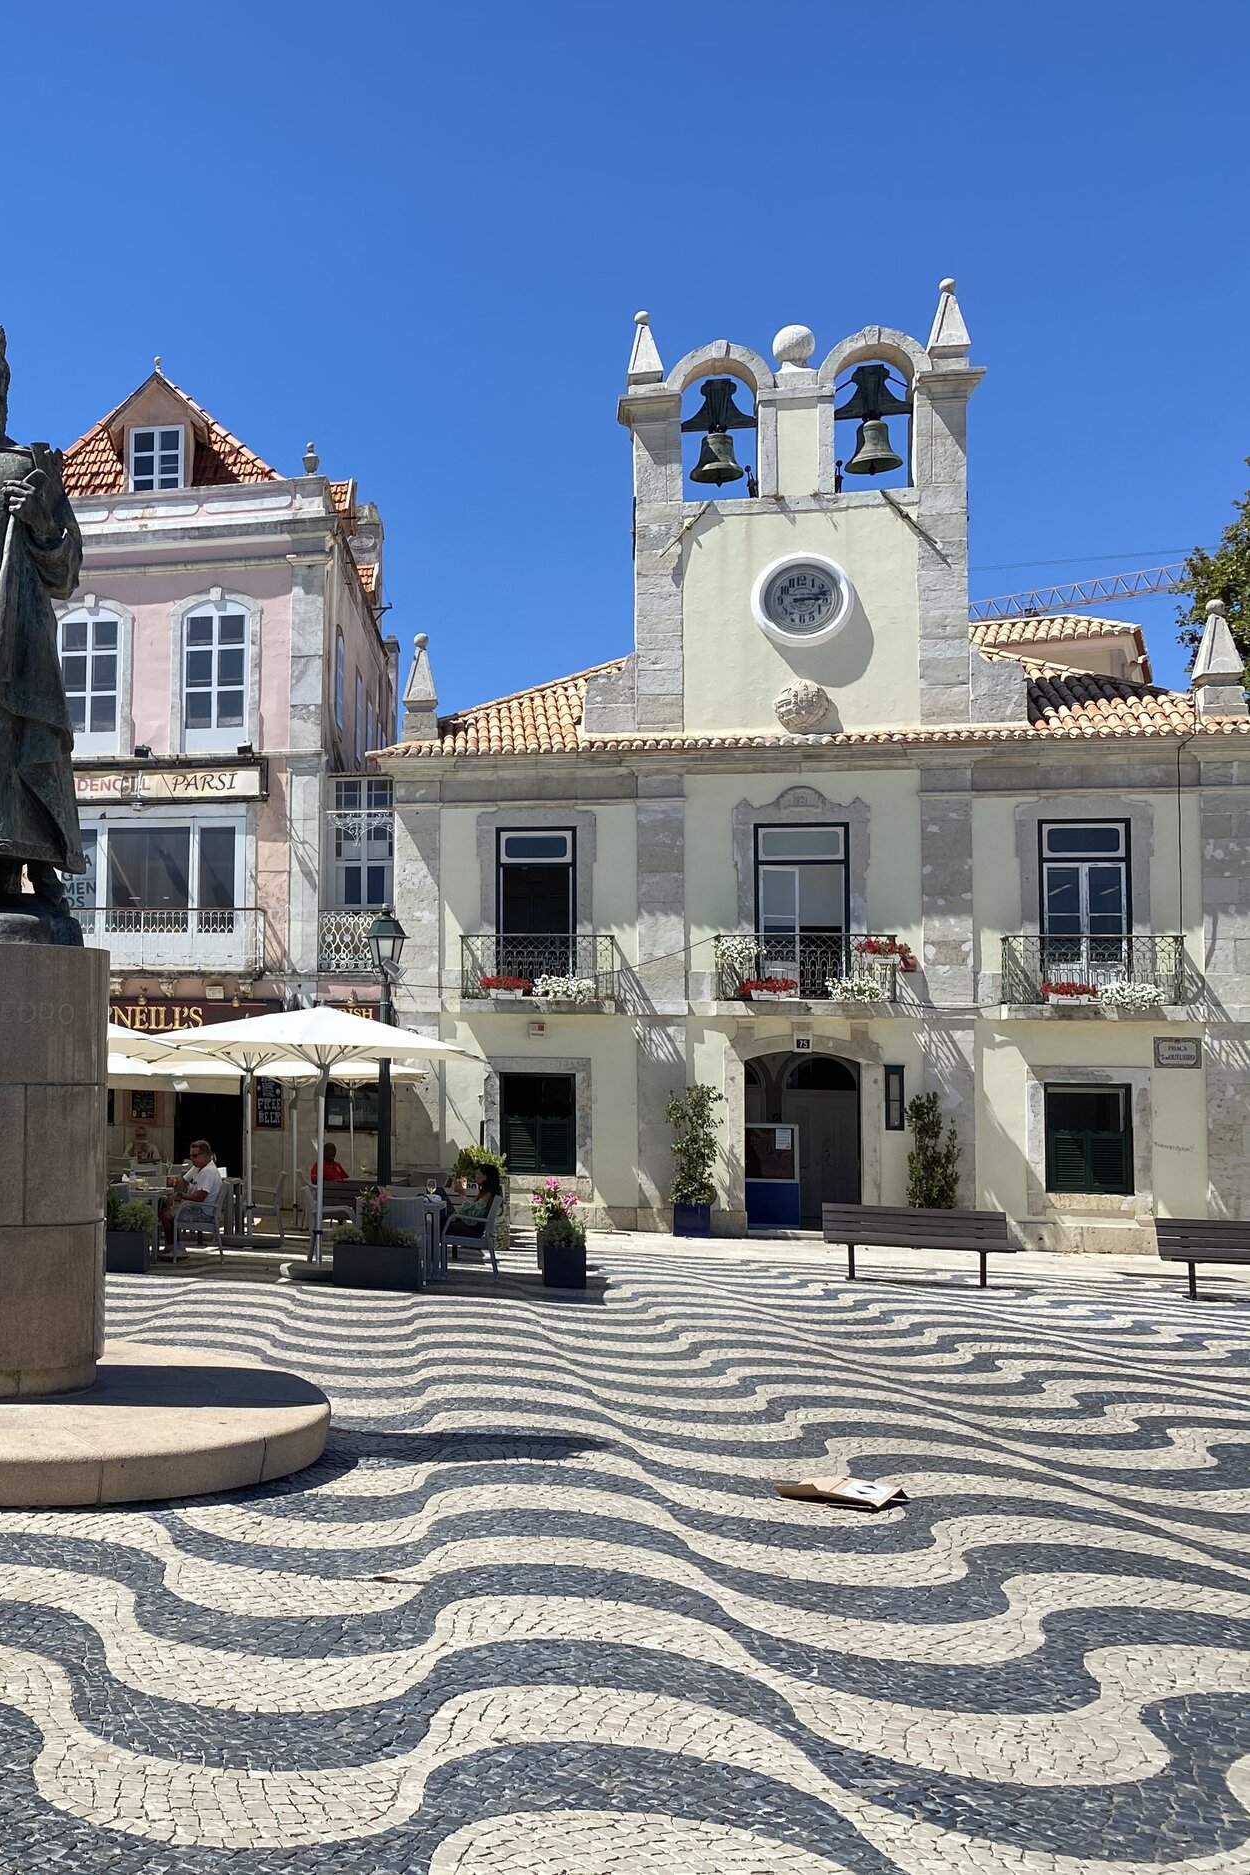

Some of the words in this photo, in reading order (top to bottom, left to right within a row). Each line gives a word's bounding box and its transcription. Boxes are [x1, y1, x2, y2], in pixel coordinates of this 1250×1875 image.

[172, 773, 239, 792] PARSI
[798, 1039, 807, 1048] 75
[257, 1097, 281, 1111] FREE
[258, 1111, 282, 1124] BEER
